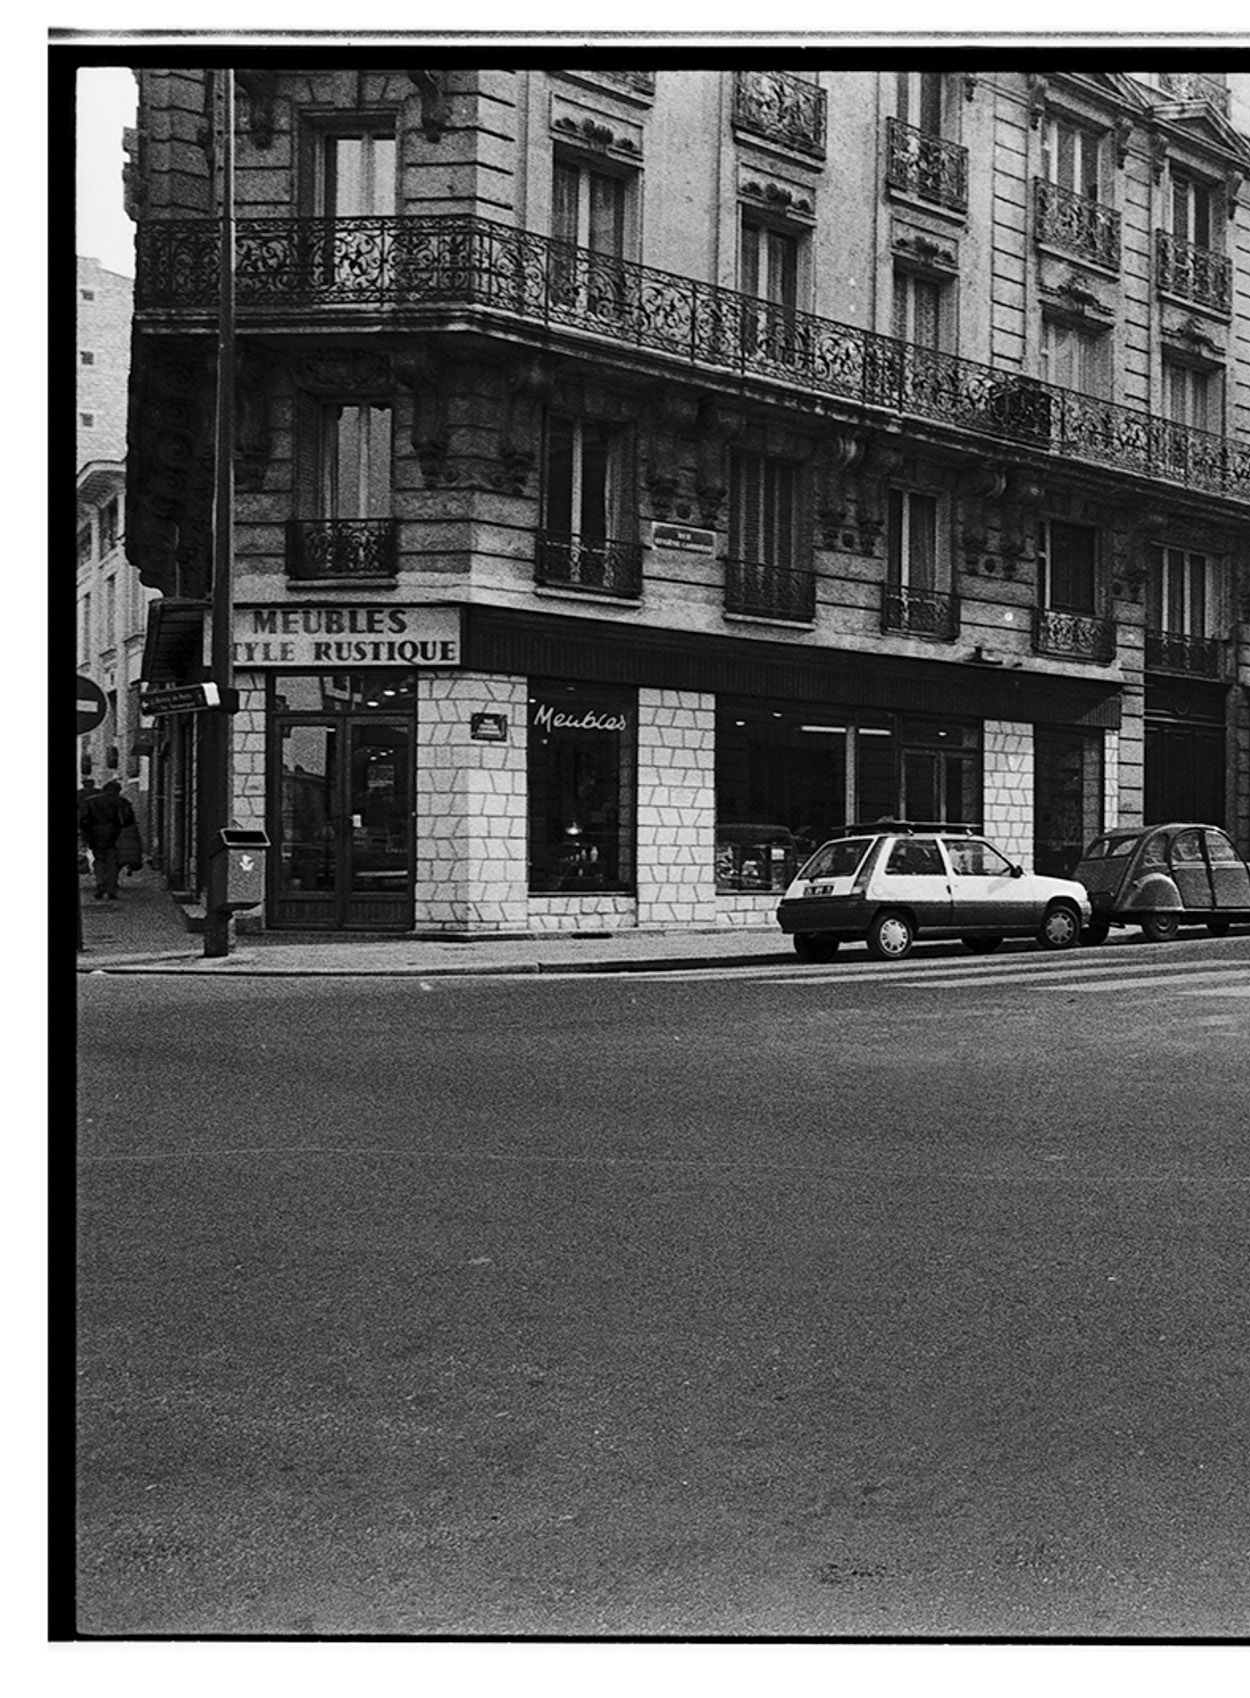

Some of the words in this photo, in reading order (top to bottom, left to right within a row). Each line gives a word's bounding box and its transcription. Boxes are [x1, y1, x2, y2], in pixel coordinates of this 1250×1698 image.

[252, 609, 408, 634] MEUBLES
[232, 641, 295, 662] TYLE
[313, 641, 456, 665] RUSTIQUE
[534, 704, 627, 732] Meubles
